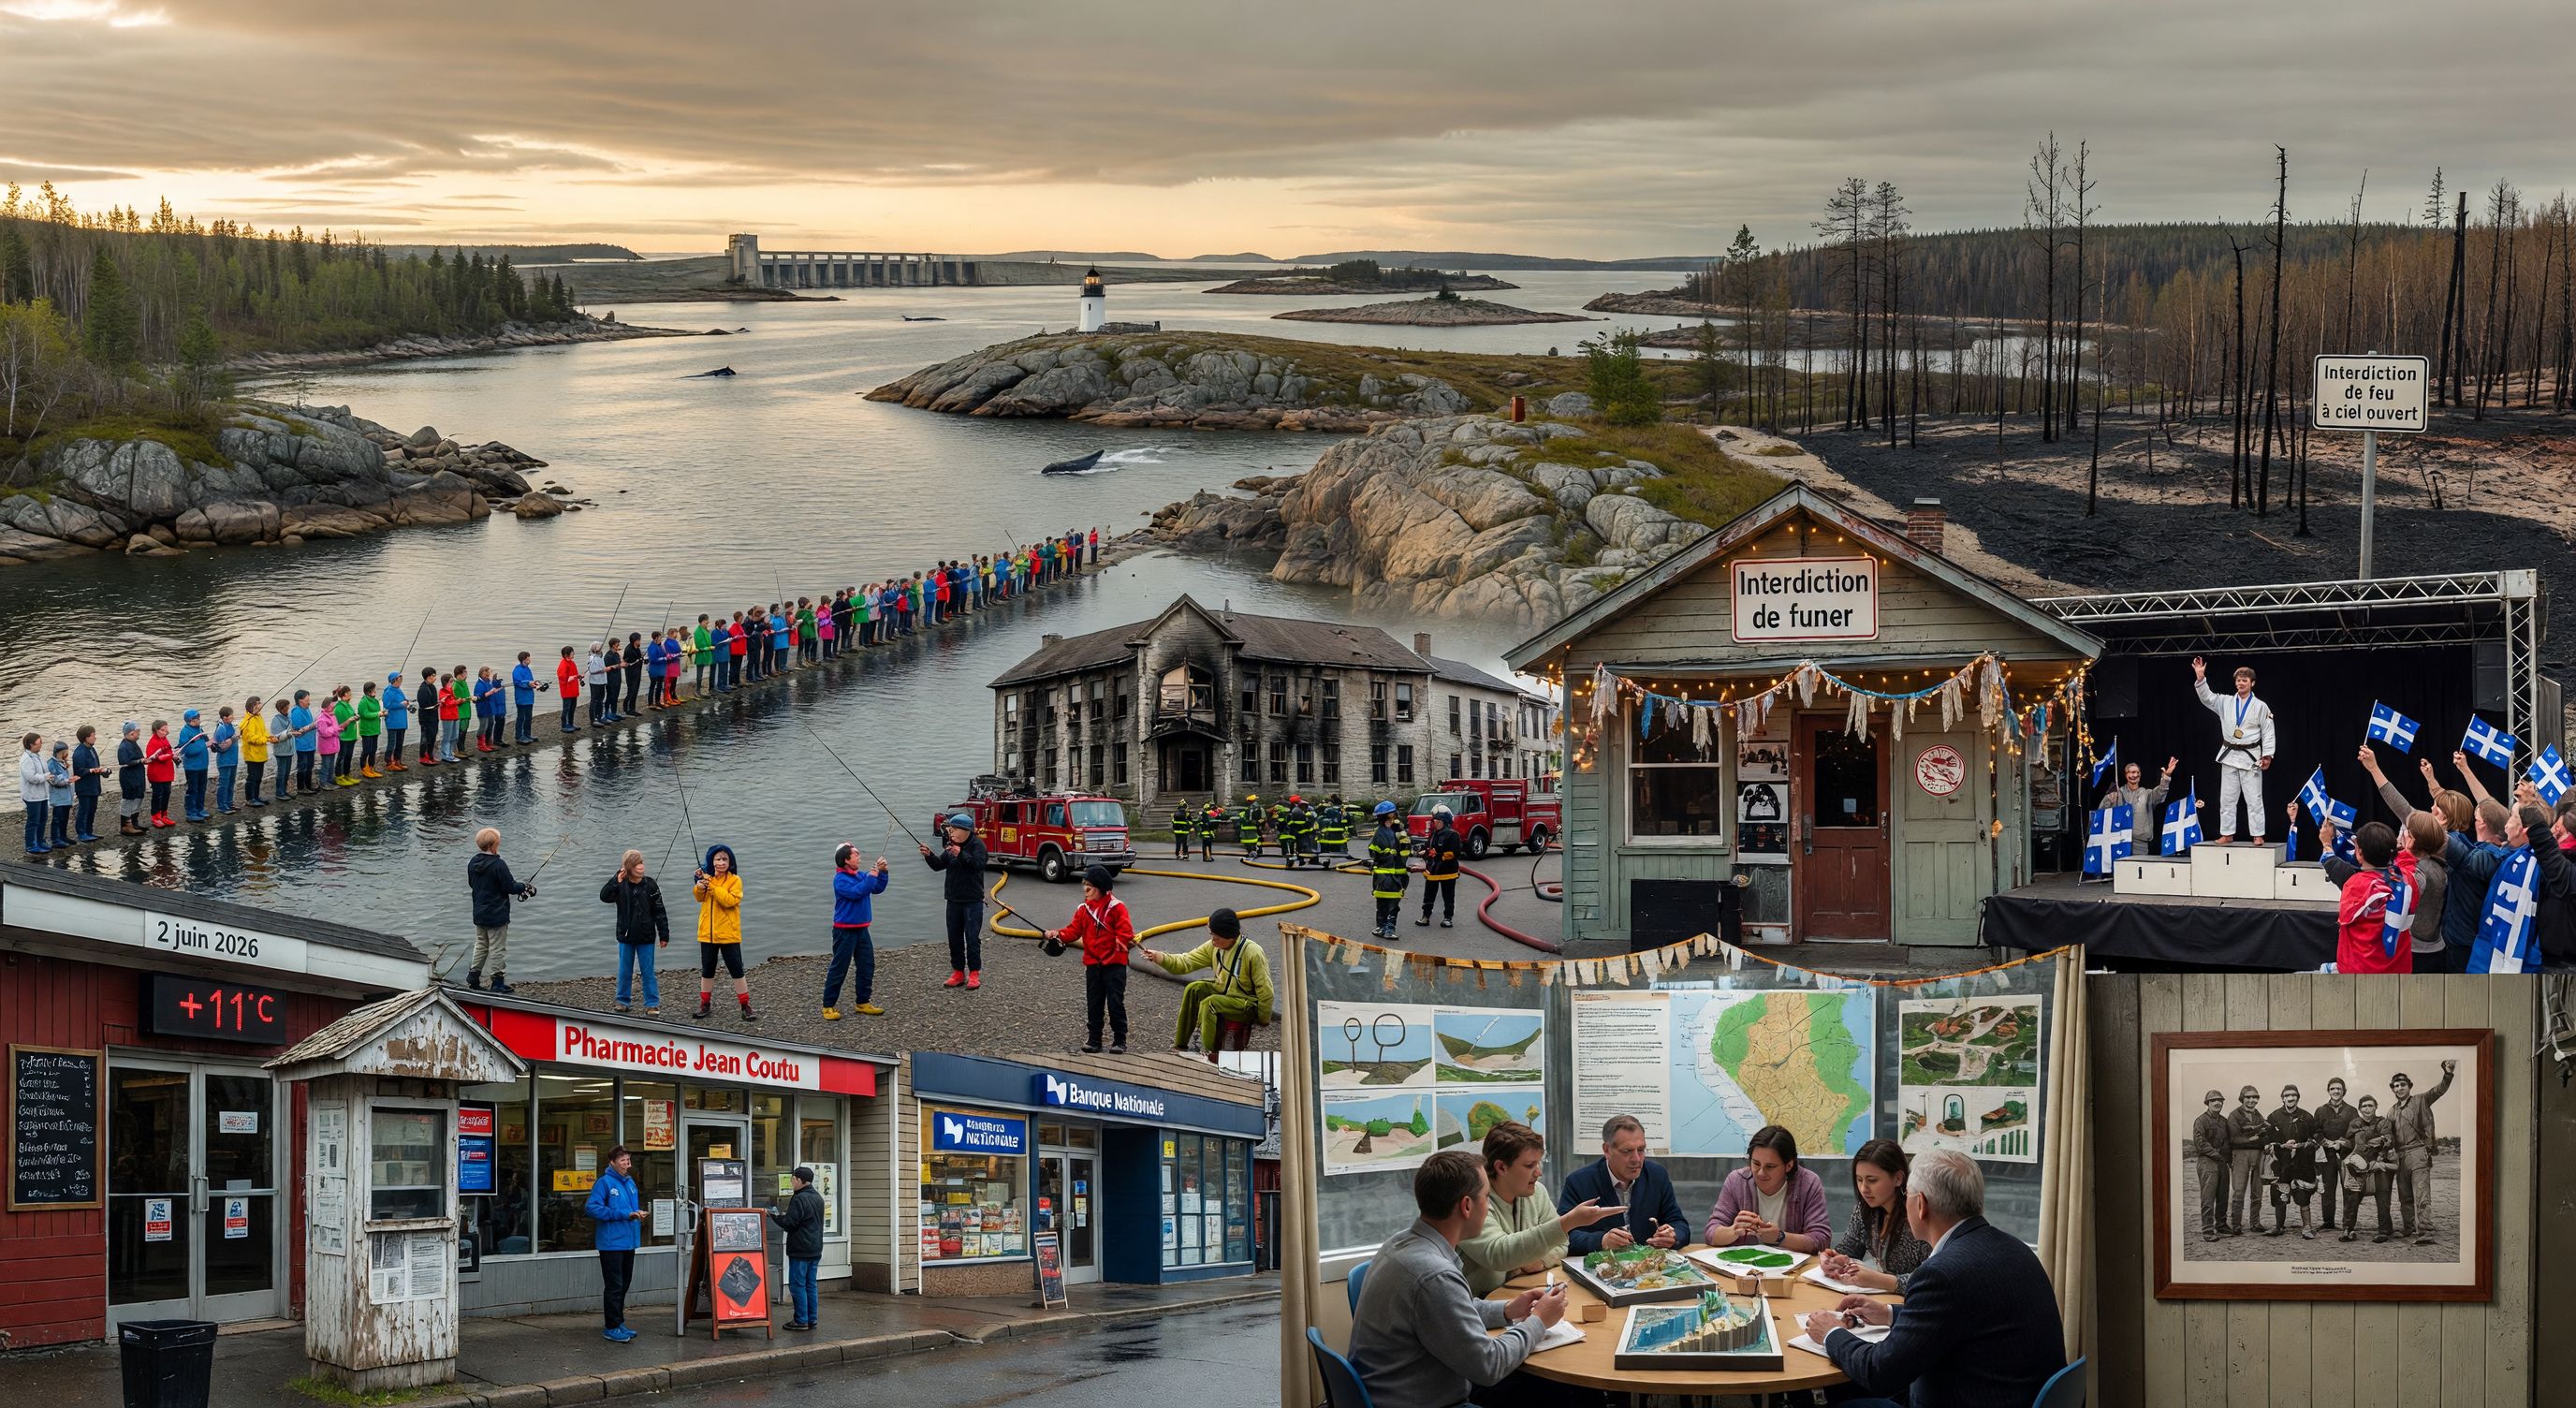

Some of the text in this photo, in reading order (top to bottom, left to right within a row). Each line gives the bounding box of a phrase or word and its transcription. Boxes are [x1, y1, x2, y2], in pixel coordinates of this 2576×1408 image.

[2324, 365, 2417, 381] Interdiction
[2345, 385, 2394, 401] de feu
[2322, 403, 2419, 421] à ciel ouvert
[1740, 567, 1868, 595] Interdiction
[1752, 602, 1853, 629] de funer
[157, 920, 259, 959] 2 juin 2026
[564, 1025, 799, 1082] Pharmacie Jean Coutu
[1069, 1083, 1164, 1117] Banque Nationale
